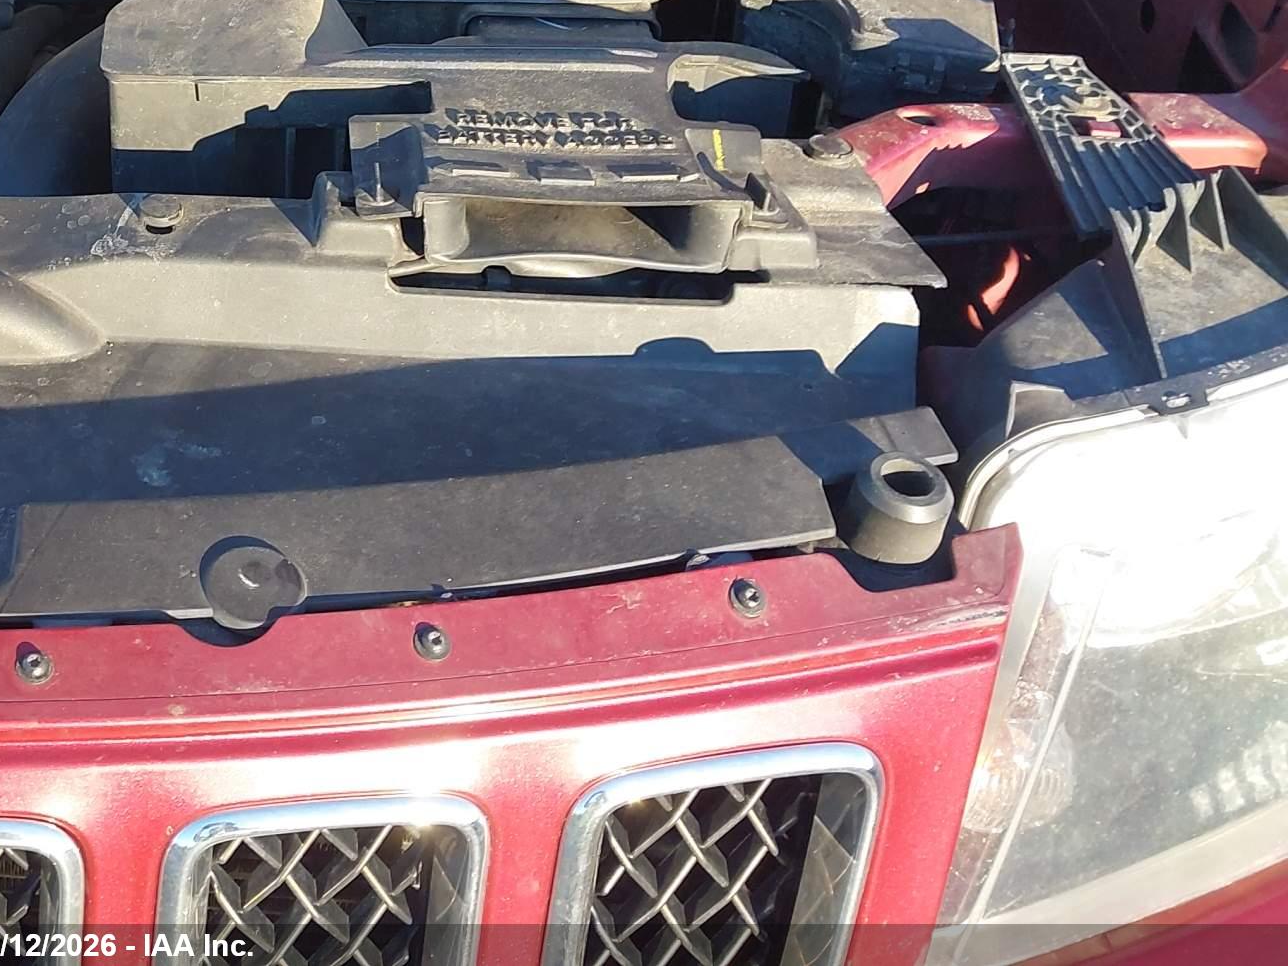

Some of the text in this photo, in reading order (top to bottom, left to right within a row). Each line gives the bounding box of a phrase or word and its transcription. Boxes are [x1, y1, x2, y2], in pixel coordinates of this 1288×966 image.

[454, 111, 638, 132] REMOVE FOR
[435, 127, 677, 151] BATTERY ACCESS
